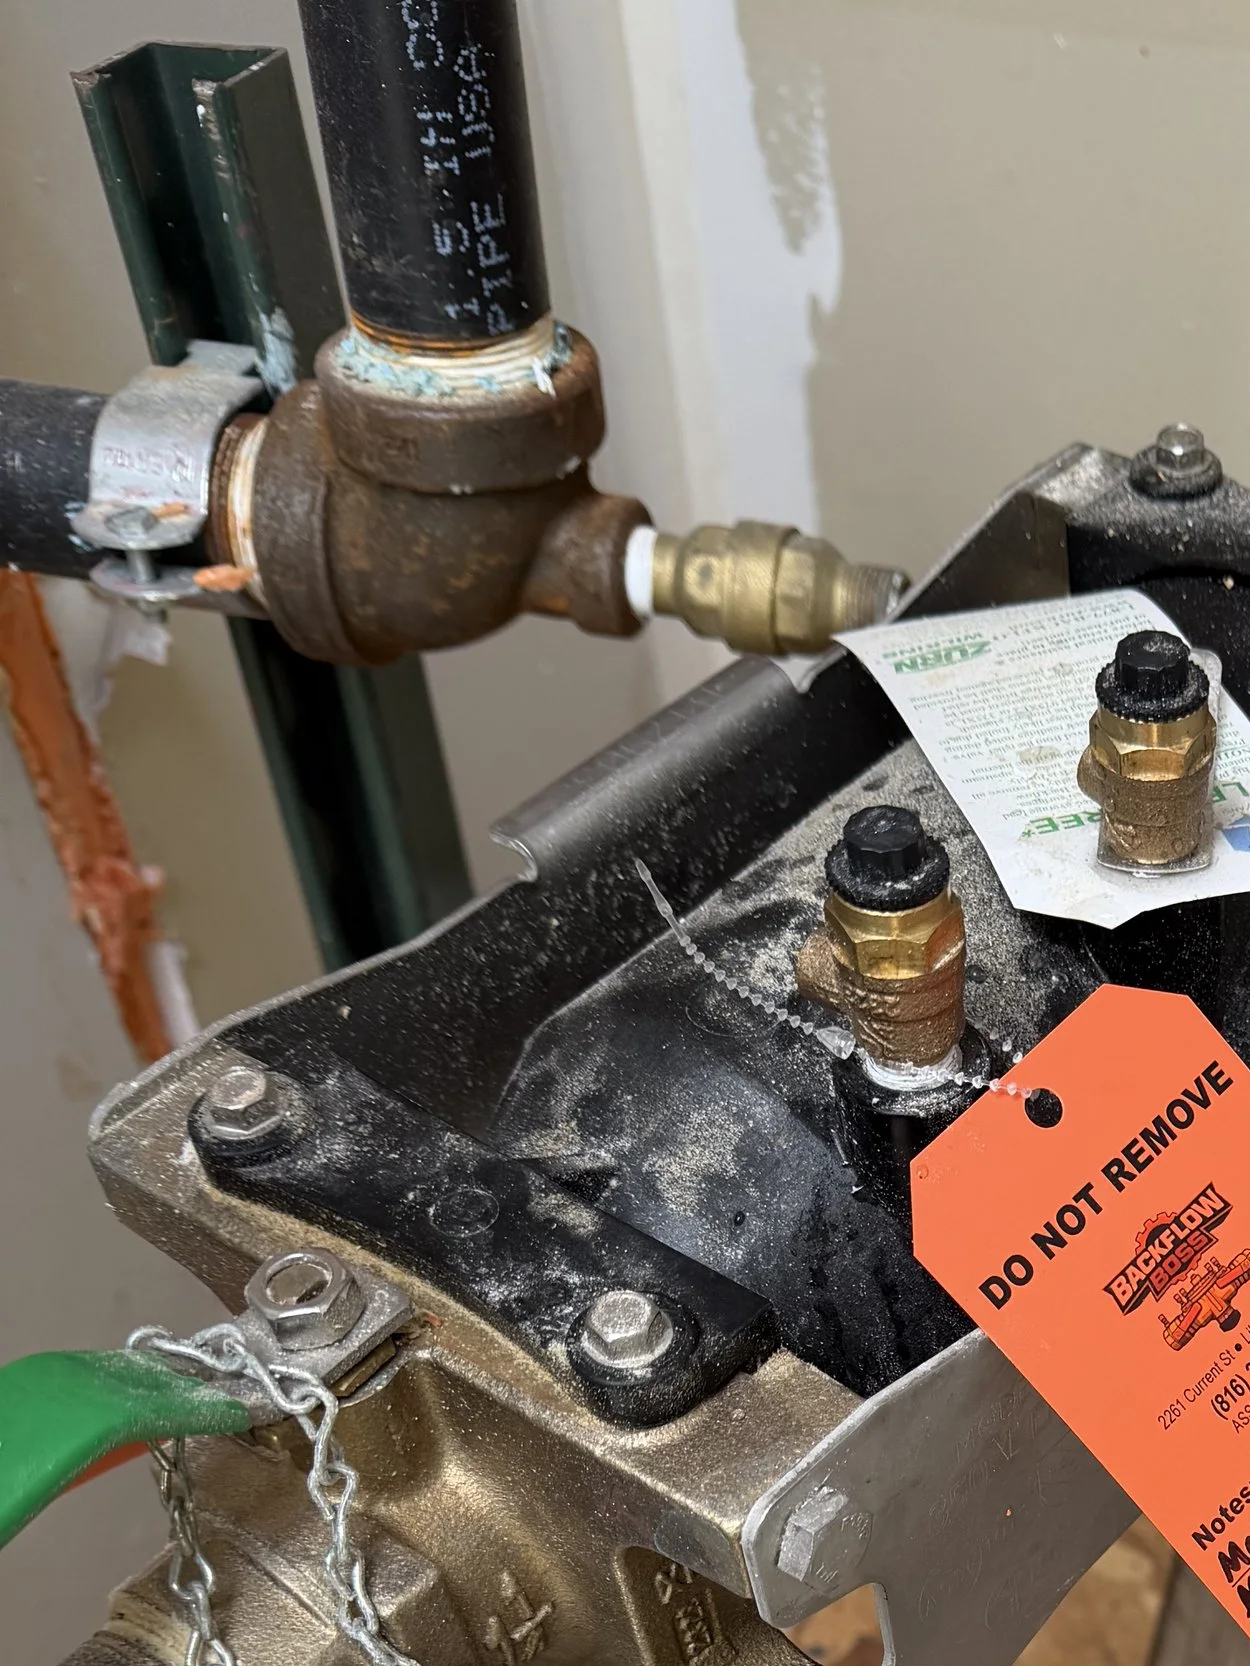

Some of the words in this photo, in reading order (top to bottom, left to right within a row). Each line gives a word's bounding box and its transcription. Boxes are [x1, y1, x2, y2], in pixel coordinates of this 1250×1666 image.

[453, 43, 495, 158] USA
[470, 192, 514, 336] PIPE
[894, 640, 992, 675] ZURN
[978, 1254, 1034, 1310] DO
[1031, 1182, 1103, 1260] NOT
[1101, 1060, 1233, 1193] REMOVE
[1105, 1184, 1229, 1307] BACKFLOW
[1145, 1226, 1211, 1292] BOSS
[1158, 1399, 1186, 1430] 2261
[1184, 1361, 1223, 1402] Current
[1219, 1350, 1235, 1366] St
